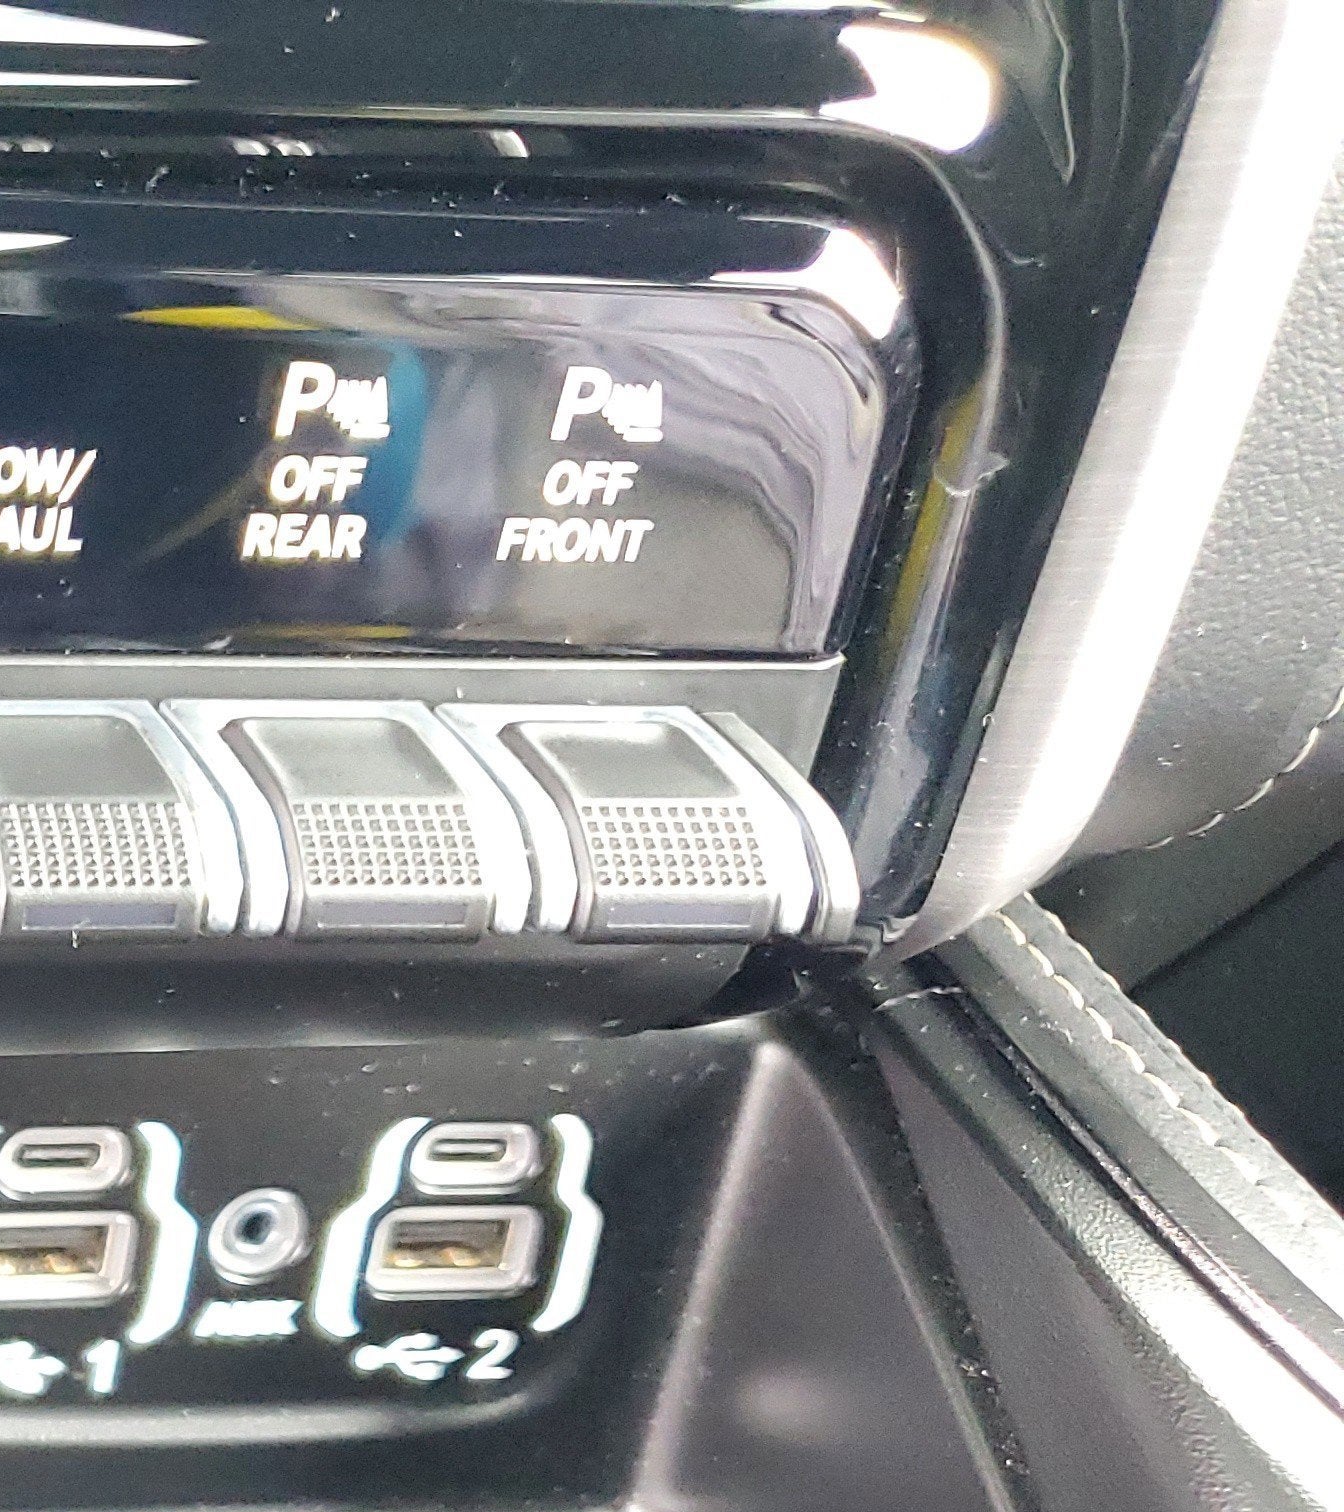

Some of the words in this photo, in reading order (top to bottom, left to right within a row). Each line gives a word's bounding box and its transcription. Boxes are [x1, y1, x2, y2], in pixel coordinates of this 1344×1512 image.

[269, 454, 368, 503] OFF
[542, 460, 639, 506] OFF
[242, 512, 367, 559] REAR
[495, 517, 655, 563] FRONT
[85, 1339, 121, 1394] 1
[465, 1328, 519, 1380] 2
